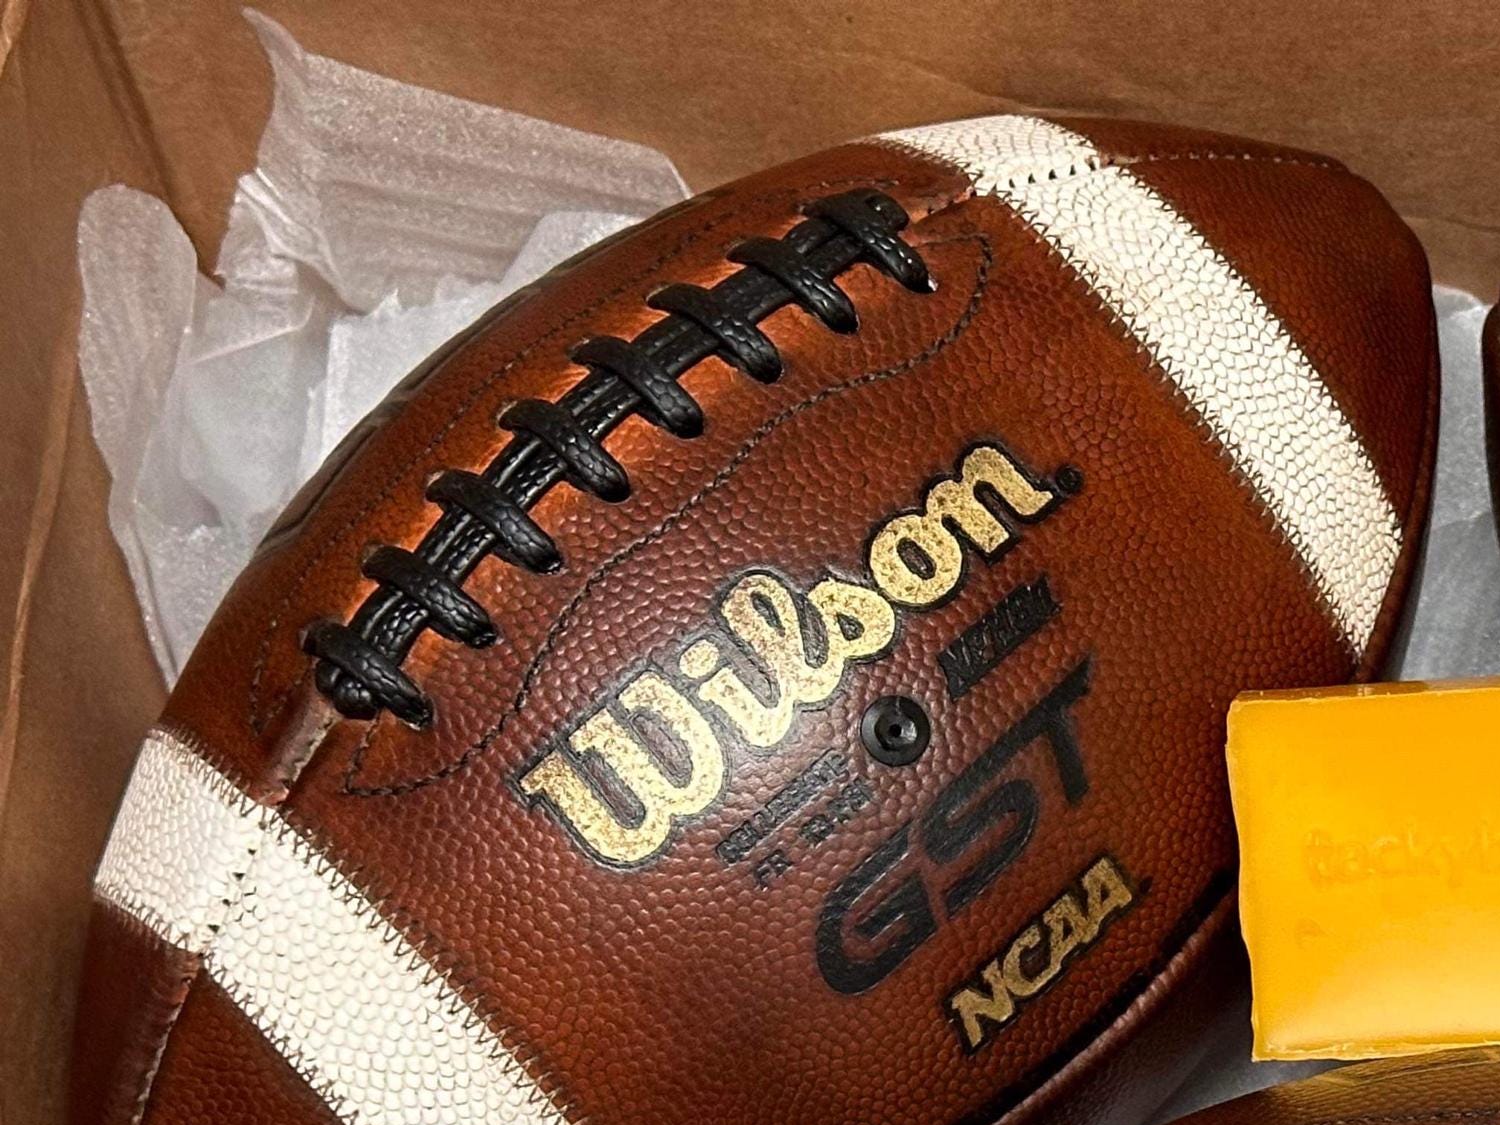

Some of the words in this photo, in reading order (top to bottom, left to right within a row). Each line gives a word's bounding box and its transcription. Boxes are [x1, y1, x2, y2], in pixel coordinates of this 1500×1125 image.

[516, 441, 1058, 868] Wilson
[816, 652, 1092, 995] GST
[944, 854, 1135, 1052] NCAA
